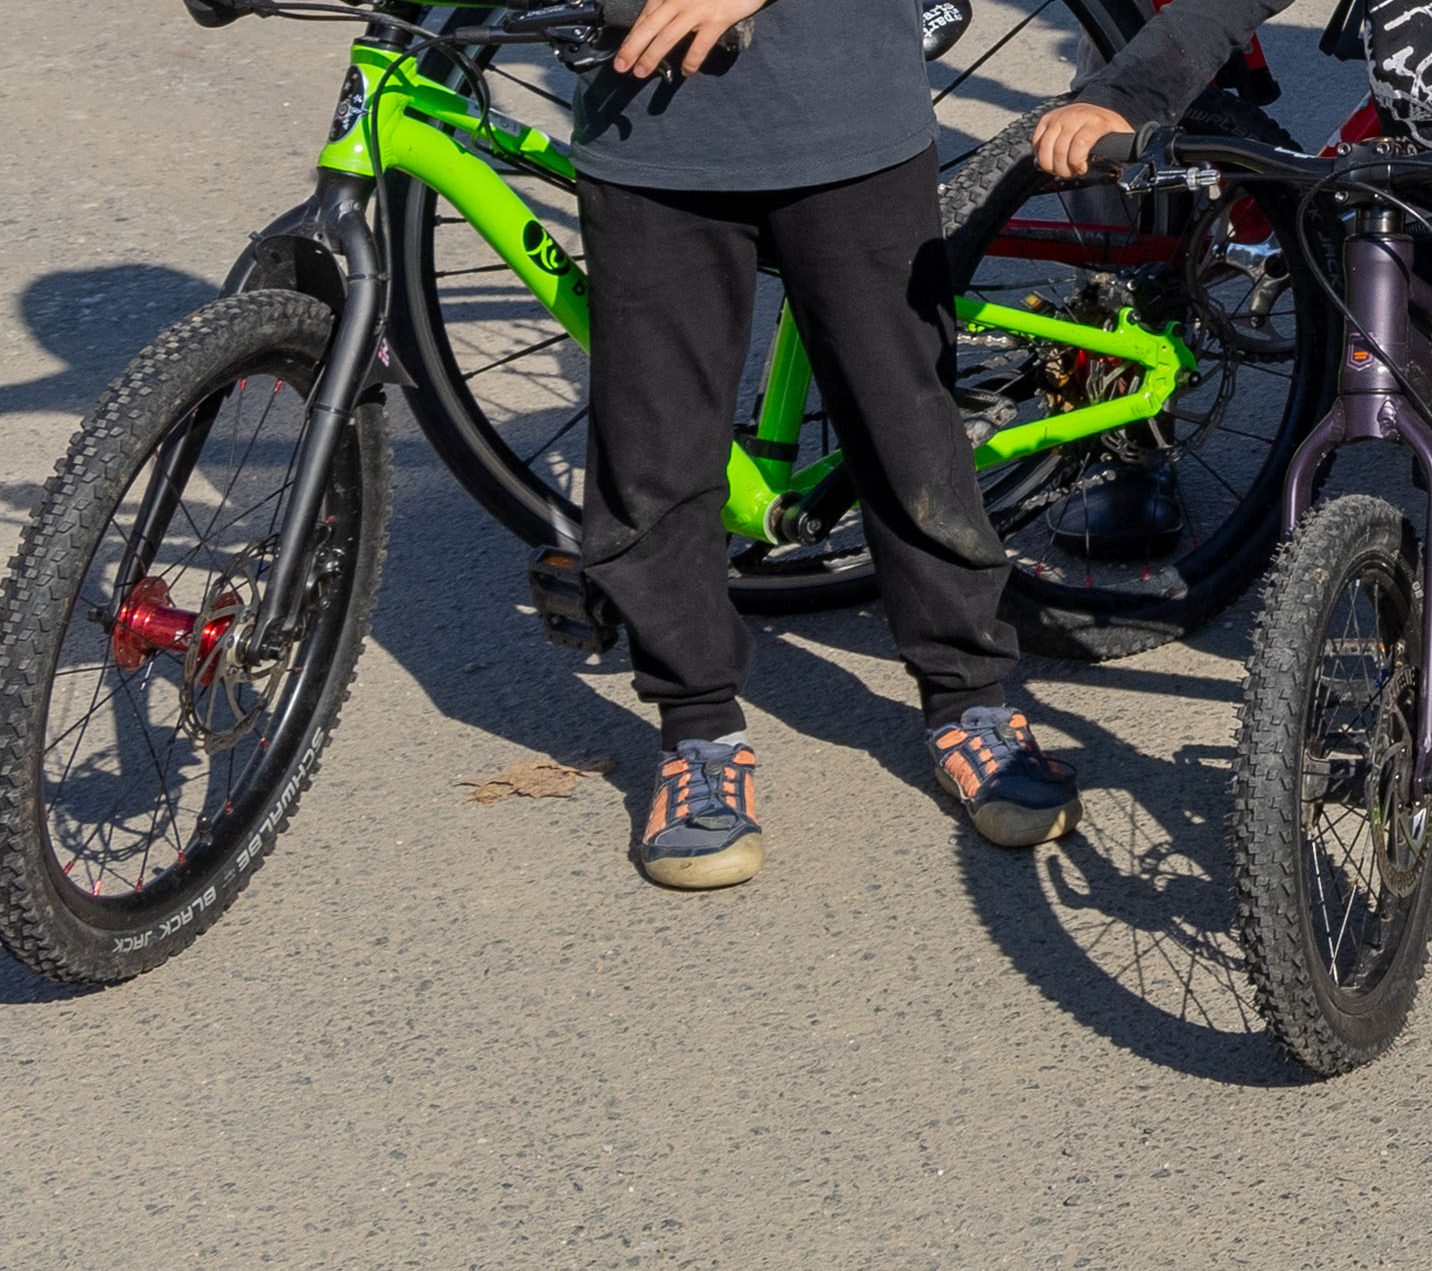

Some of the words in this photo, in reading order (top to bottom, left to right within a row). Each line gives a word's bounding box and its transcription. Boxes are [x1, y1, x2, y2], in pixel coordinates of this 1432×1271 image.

[235, 725, 326, 874] SCHWALBE
[159, 885, 218, 941] BLACK
[112, 928, 154, 955] JACK
